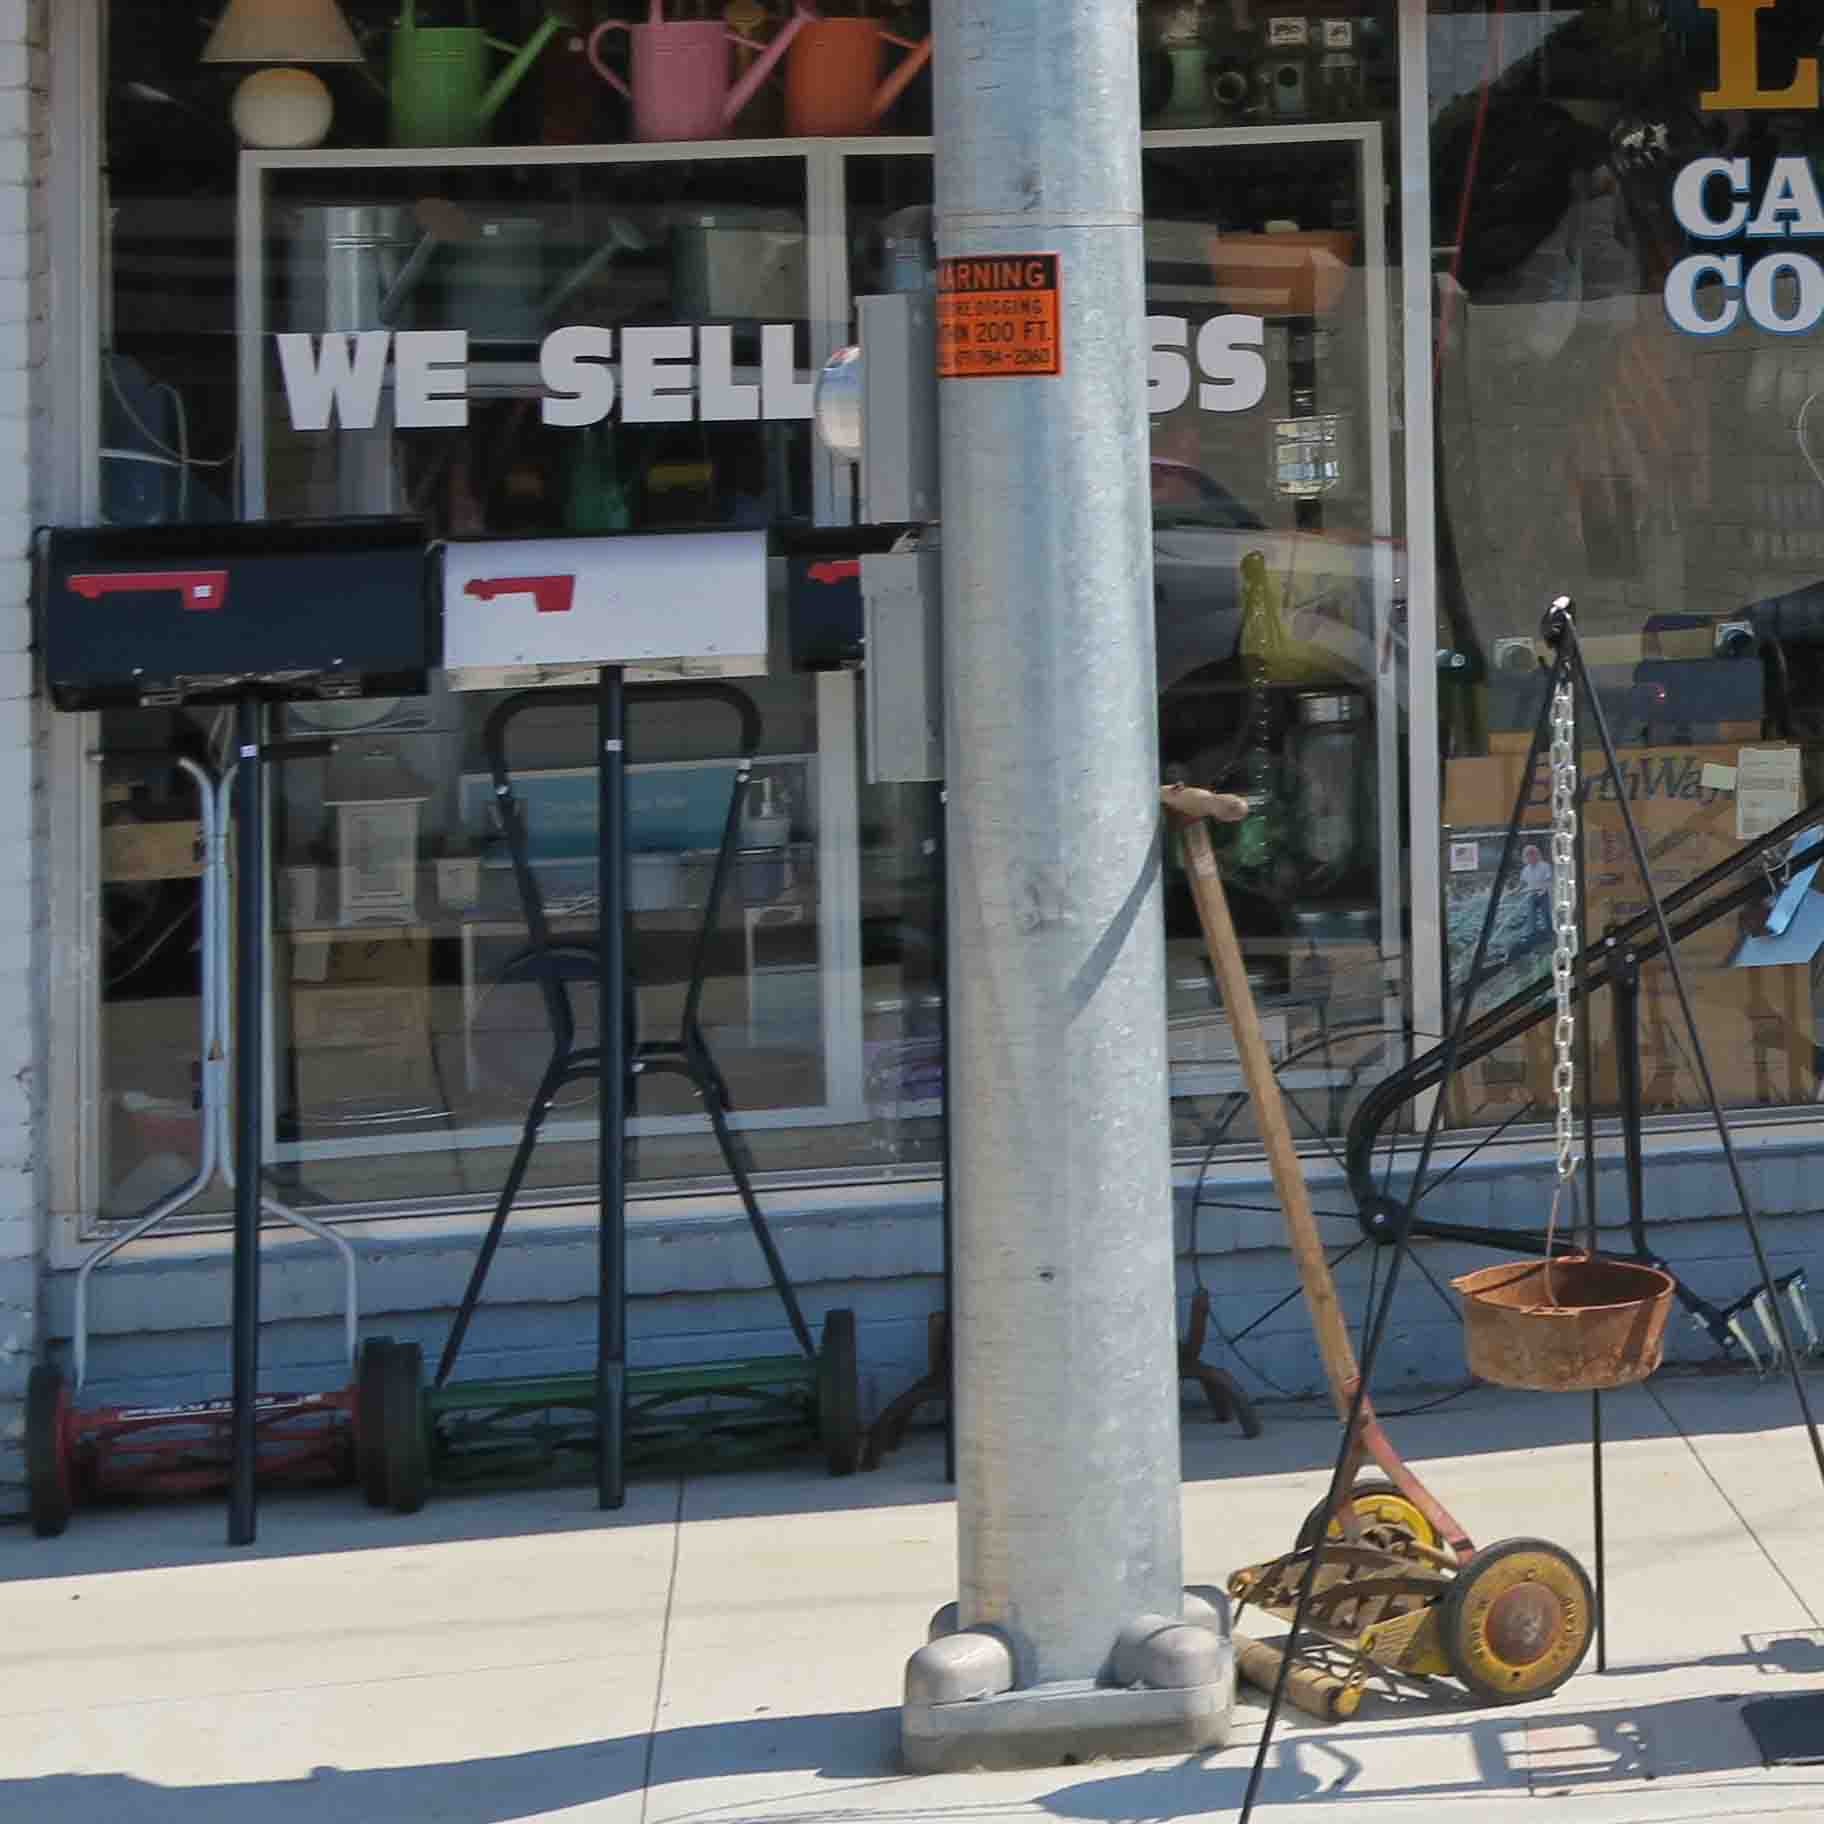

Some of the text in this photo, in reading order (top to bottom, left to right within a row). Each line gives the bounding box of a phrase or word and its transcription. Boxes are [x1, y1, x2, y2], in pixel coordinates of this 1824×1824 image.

[940, 262, 1045, 290] ARNING
[976, 321, 1015, 342] 200
[277, 324, 814, 430] WE SELL
